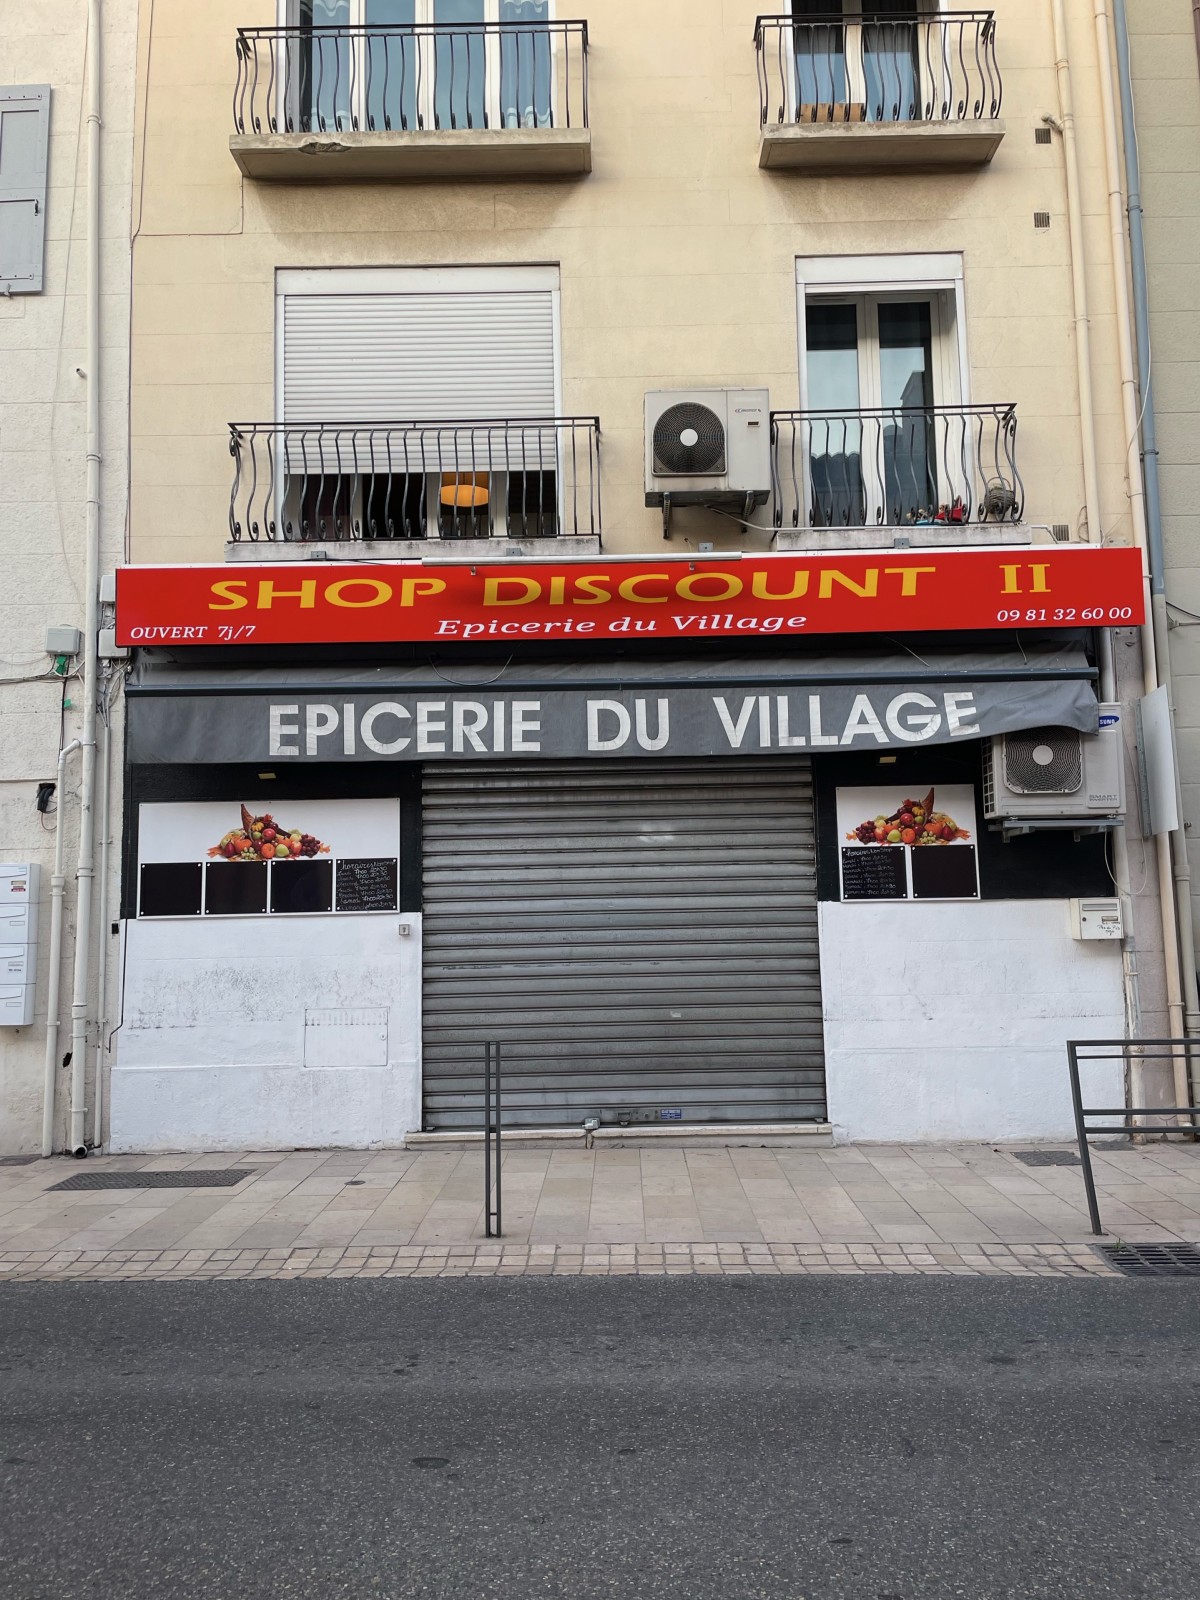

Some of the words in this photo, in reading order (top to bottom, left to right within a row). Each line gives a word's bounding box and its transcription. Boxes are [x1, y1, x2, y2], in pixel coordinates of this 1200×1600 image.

[209, 578, 447, 610] SHOP
[483, 566, 936, 607] DISCOUNT
[1001, 563, 1050, 593] II
[434, 618, 596, 638] Epicerie
[608, 616, 656, 632] du
[671, 613, 808, 632] Village
[997, 609, 1021, 622] 09
[1025, 609, 1046, 621] 81
[1053, 609, 1076, 621] 32
[1081, 608, 1104, 620] 60
[1107, 608, 1132, 620] 00
[130, 626, 208, 639] OUVERT
[218, 625, 256, 641] 7j/7
[268, 700, 541, 757] EPICERIE
[586, 698, 670, 752] DU
[712, 691, 981, 749] VILLAGE
